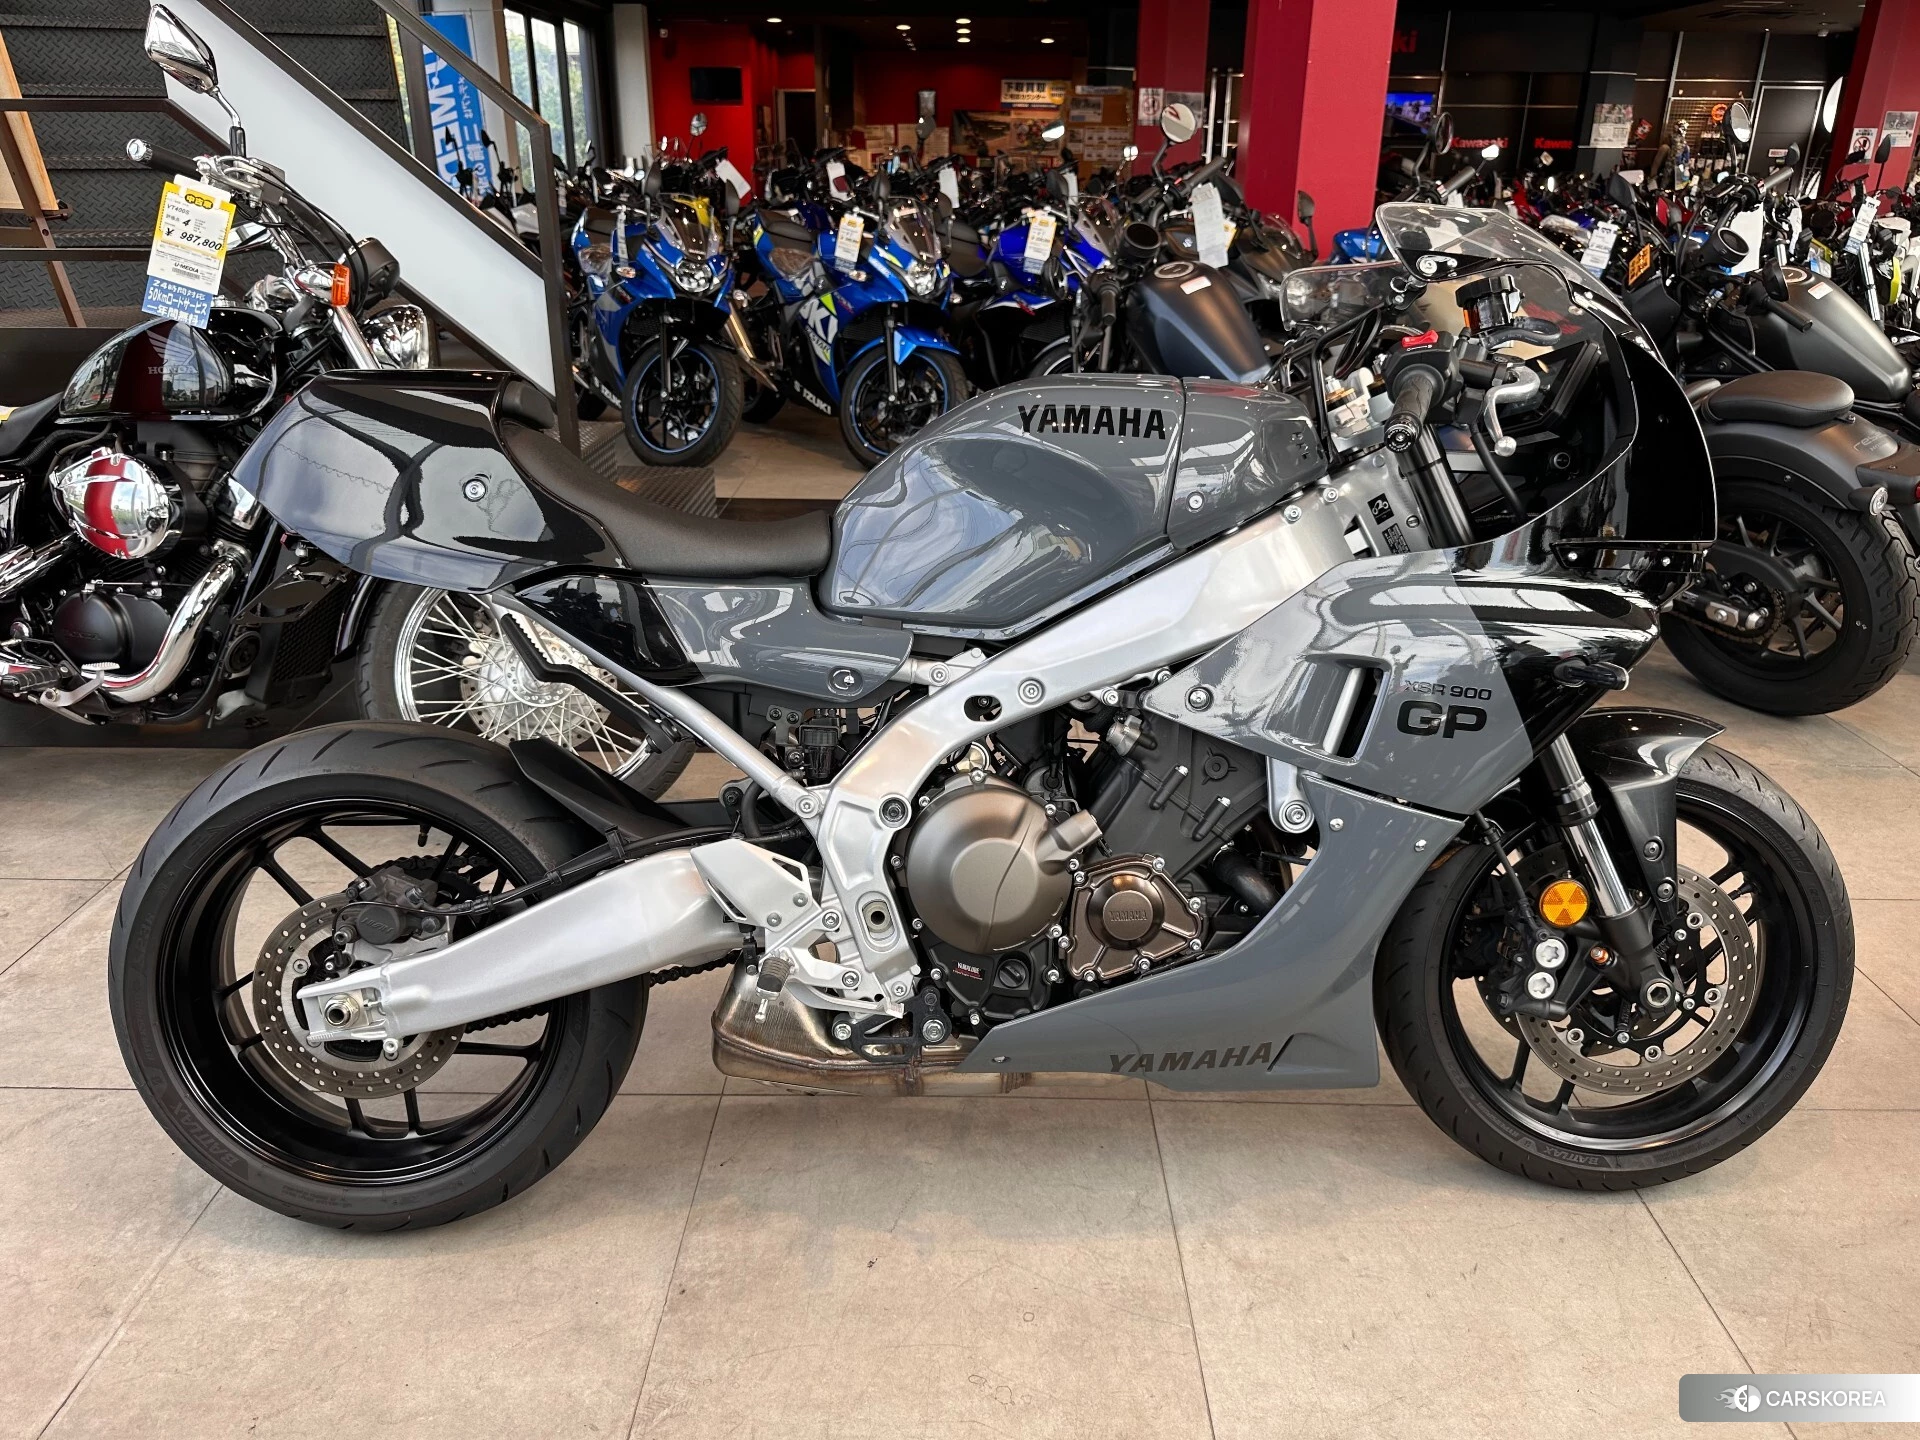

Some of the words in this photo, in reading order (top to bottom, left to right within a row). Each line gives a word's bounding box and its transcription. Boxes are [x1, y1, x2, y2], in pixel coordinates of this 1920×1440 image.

[183, 219, 191, 227] 4
[180, 232, 222, 251] 987,800
[153, 280, 206, 301] 24時間対応
[148, 366, 199, 375] HONDA
[1018, 404, 1166, 440] YAMAHA
[1405, 680, 1446, 696] XSR
[1450, 685, 1492, 700] 900
[1397, 700, 1487, 739] GP
[1109, 909, 1147, 921] YAMAHA
[1109, 1041, 1273, 1073] YAMAHA
[1544, 1147, 1601, 1166] BATTLAX
